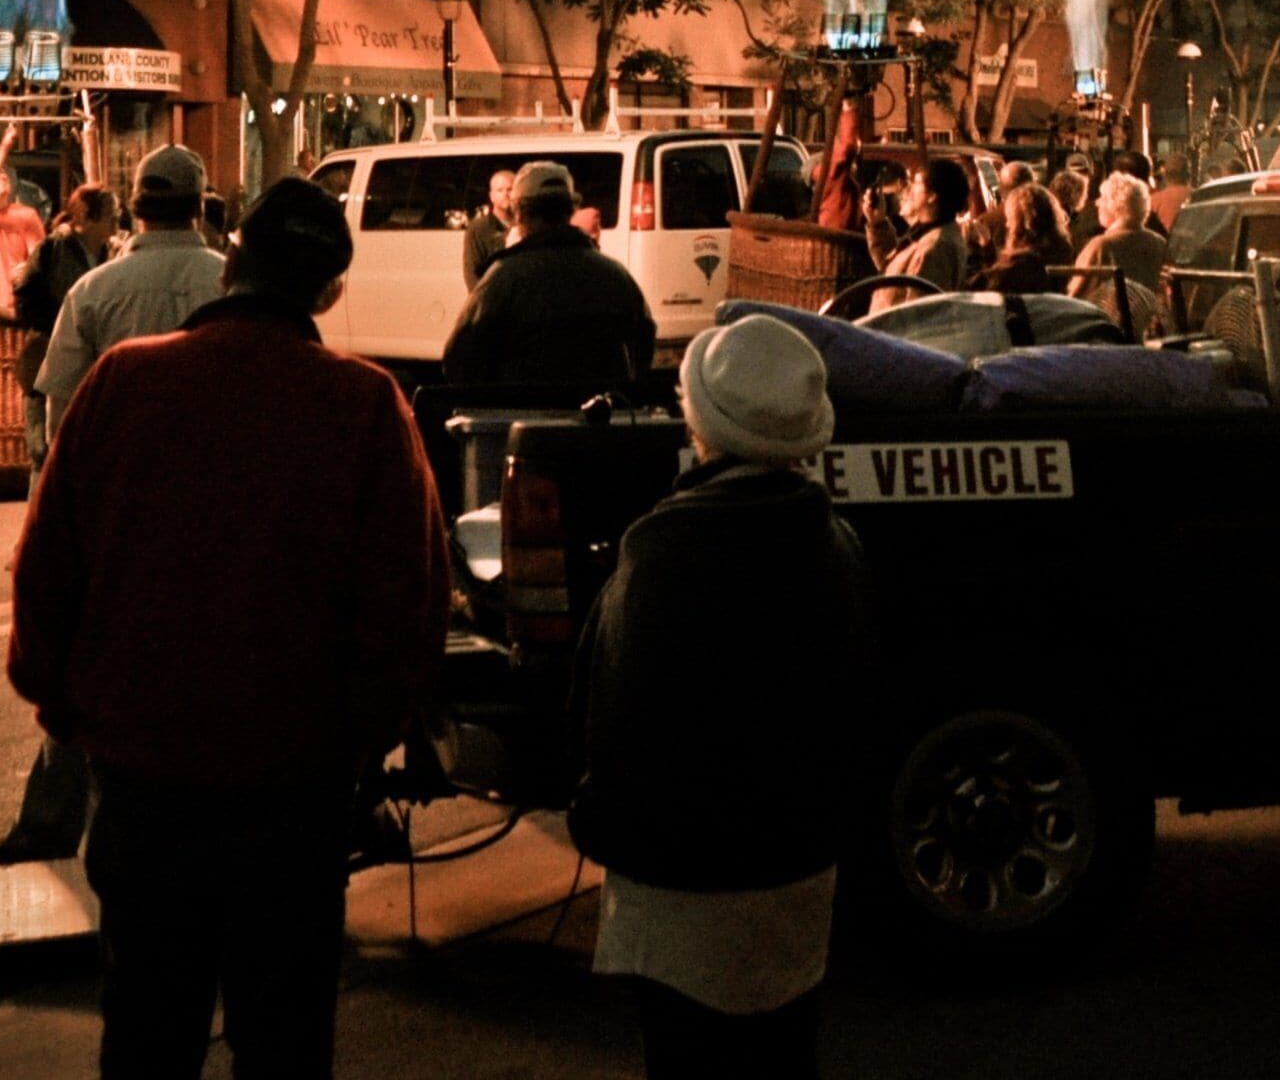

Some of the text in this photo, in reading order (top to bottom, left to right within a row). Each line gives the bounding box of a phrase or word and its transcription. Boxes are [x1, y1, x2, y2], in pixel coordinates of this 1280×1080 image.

[353, 23, 399, 50] Pear
[72, 52, 170, 69] MIDLAND COUNTY
[870, 445, 1062, 497] VEHICLE
